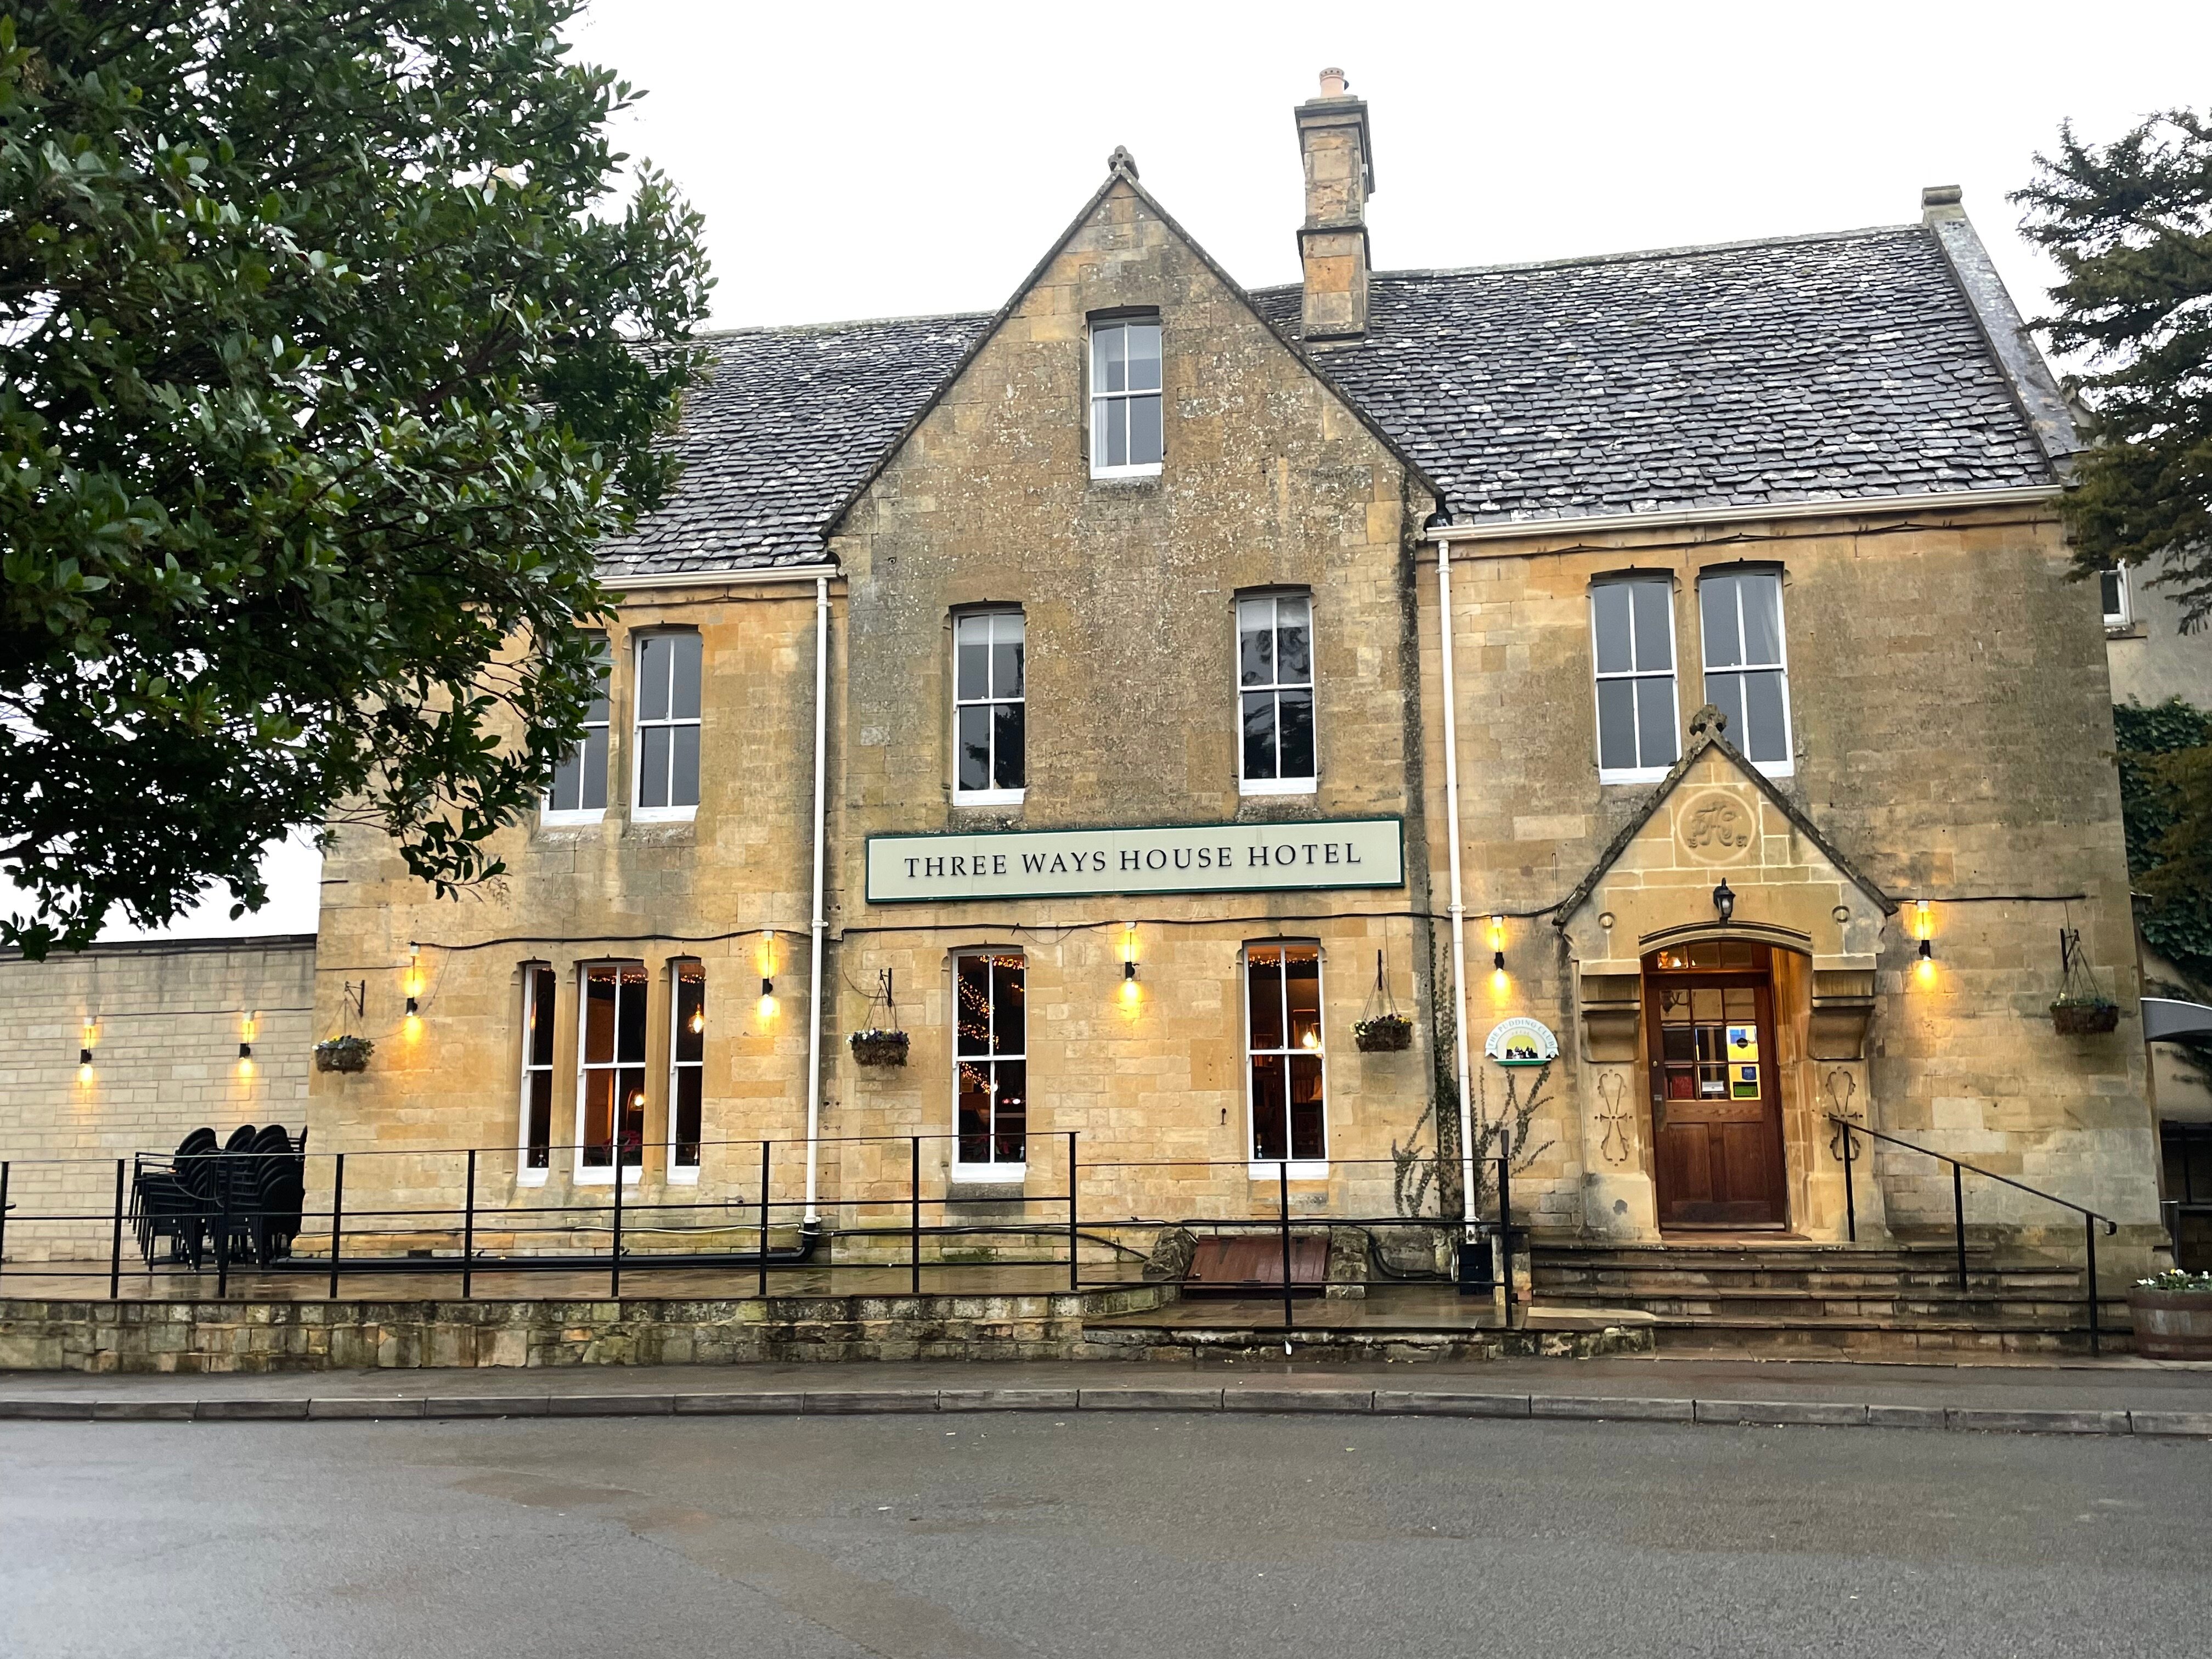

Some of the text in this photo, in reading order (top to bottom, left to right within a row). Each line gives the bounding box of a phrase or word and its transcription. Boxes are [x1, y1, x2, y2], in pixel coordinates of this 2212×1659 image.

[904, 843, 1362, 878] THREE WAYS HOUSE HOTEL
[1488, 1031, 1499, 1047] THE
[1498, 1019, 1537, 1031] PUDDING
[1538, 1026, 1555, 1047] CLUB
